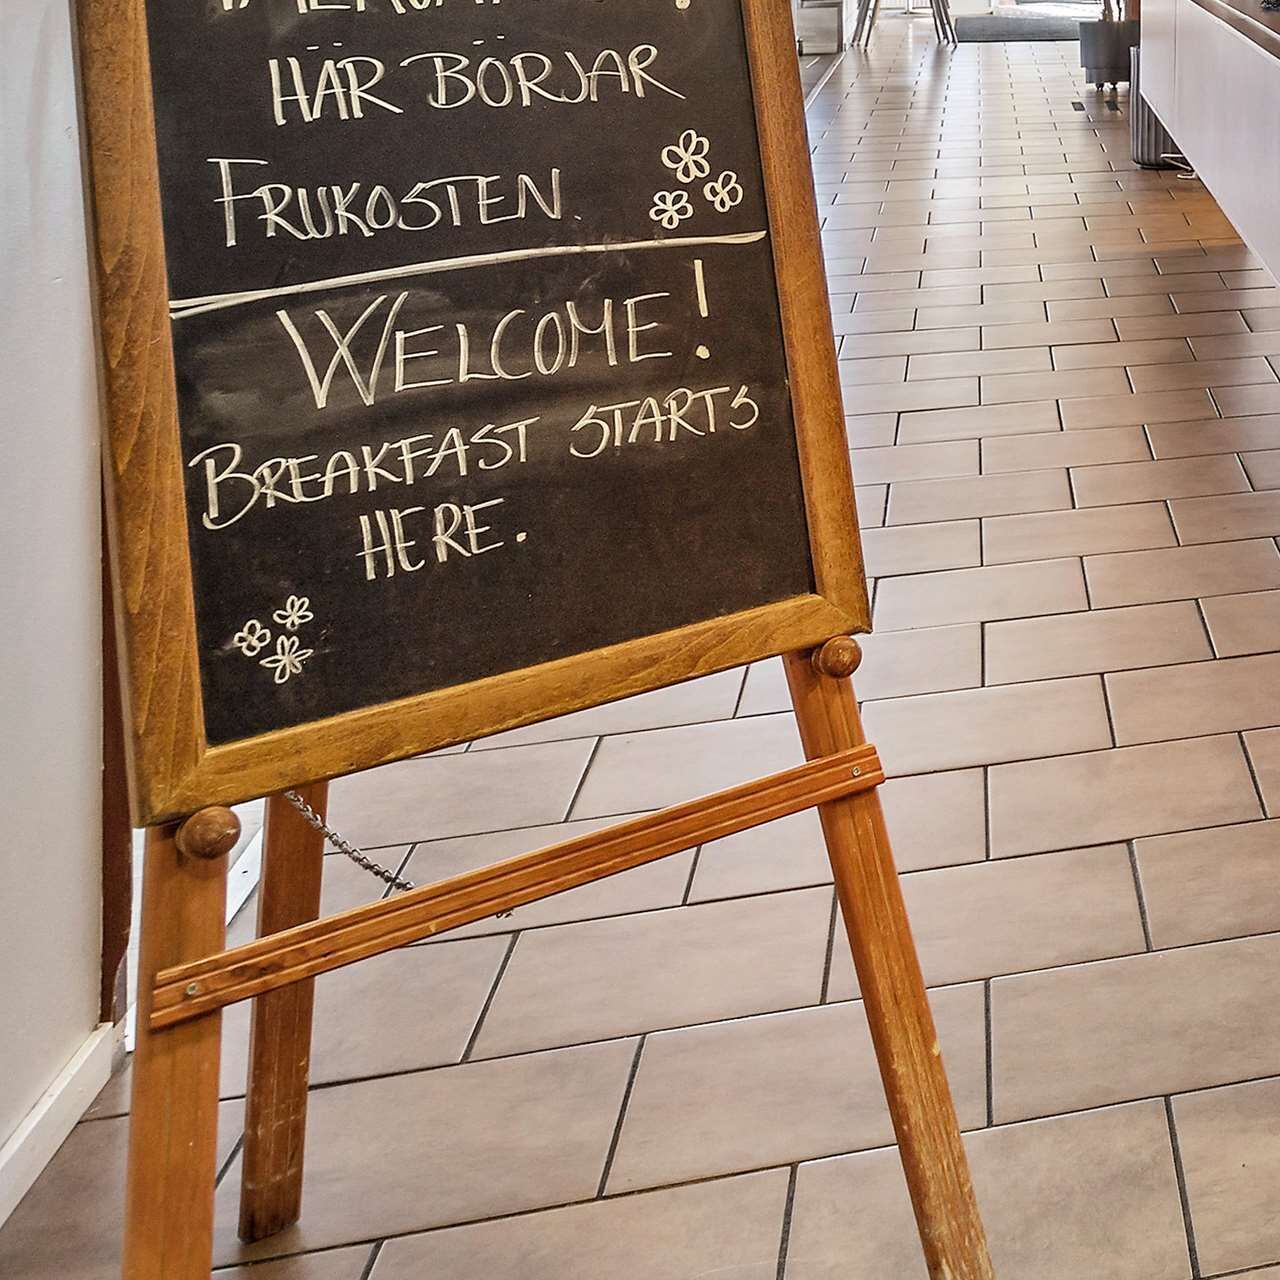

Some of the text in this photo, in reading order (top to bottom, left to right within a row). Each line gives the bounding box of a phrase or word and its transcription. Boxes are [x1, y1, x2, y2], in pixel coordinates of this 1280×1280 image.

[268, 32, 686, 124] HÄR BÖRJAR
[187, 383, 761, 530] BREAKFAST STARTS
[355, 498, 528, 582] HERE.
